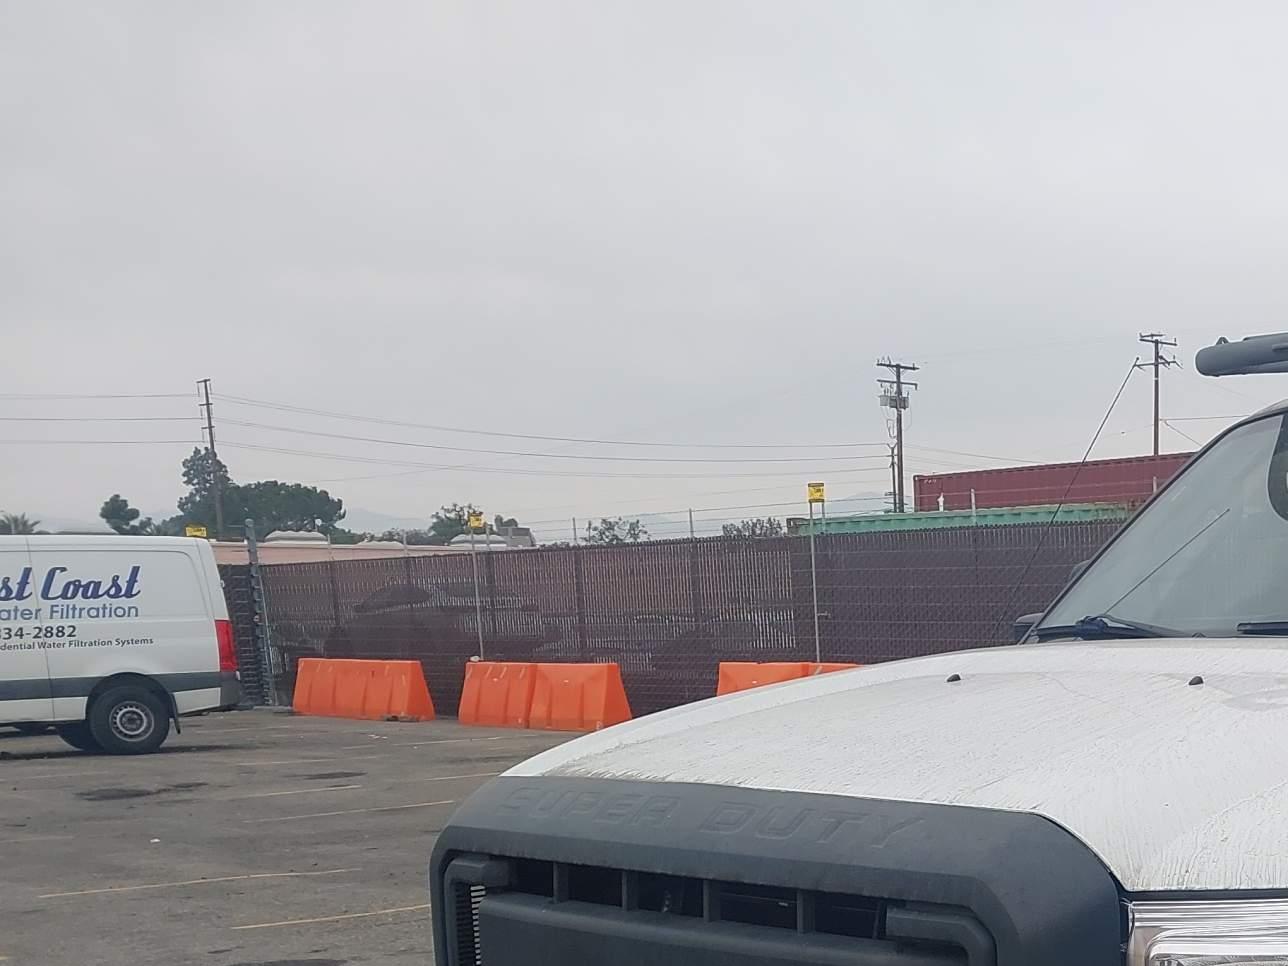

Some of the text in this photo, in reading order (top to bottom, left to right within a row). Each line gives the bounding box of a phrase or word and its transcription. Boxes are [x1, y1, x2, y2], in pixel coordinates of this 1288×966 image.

[41, 566, 141, 600] Coast
[0, 604, 139, 621] ater Filtration
[0, 625, 77, 640] 34-2882
[38, 641, 66, 650] Water
[68, 639, 112, 649] Filtration
[115, 637, 154, 648] Systems
[495, 785, 927, 849] SUPER DUTY
